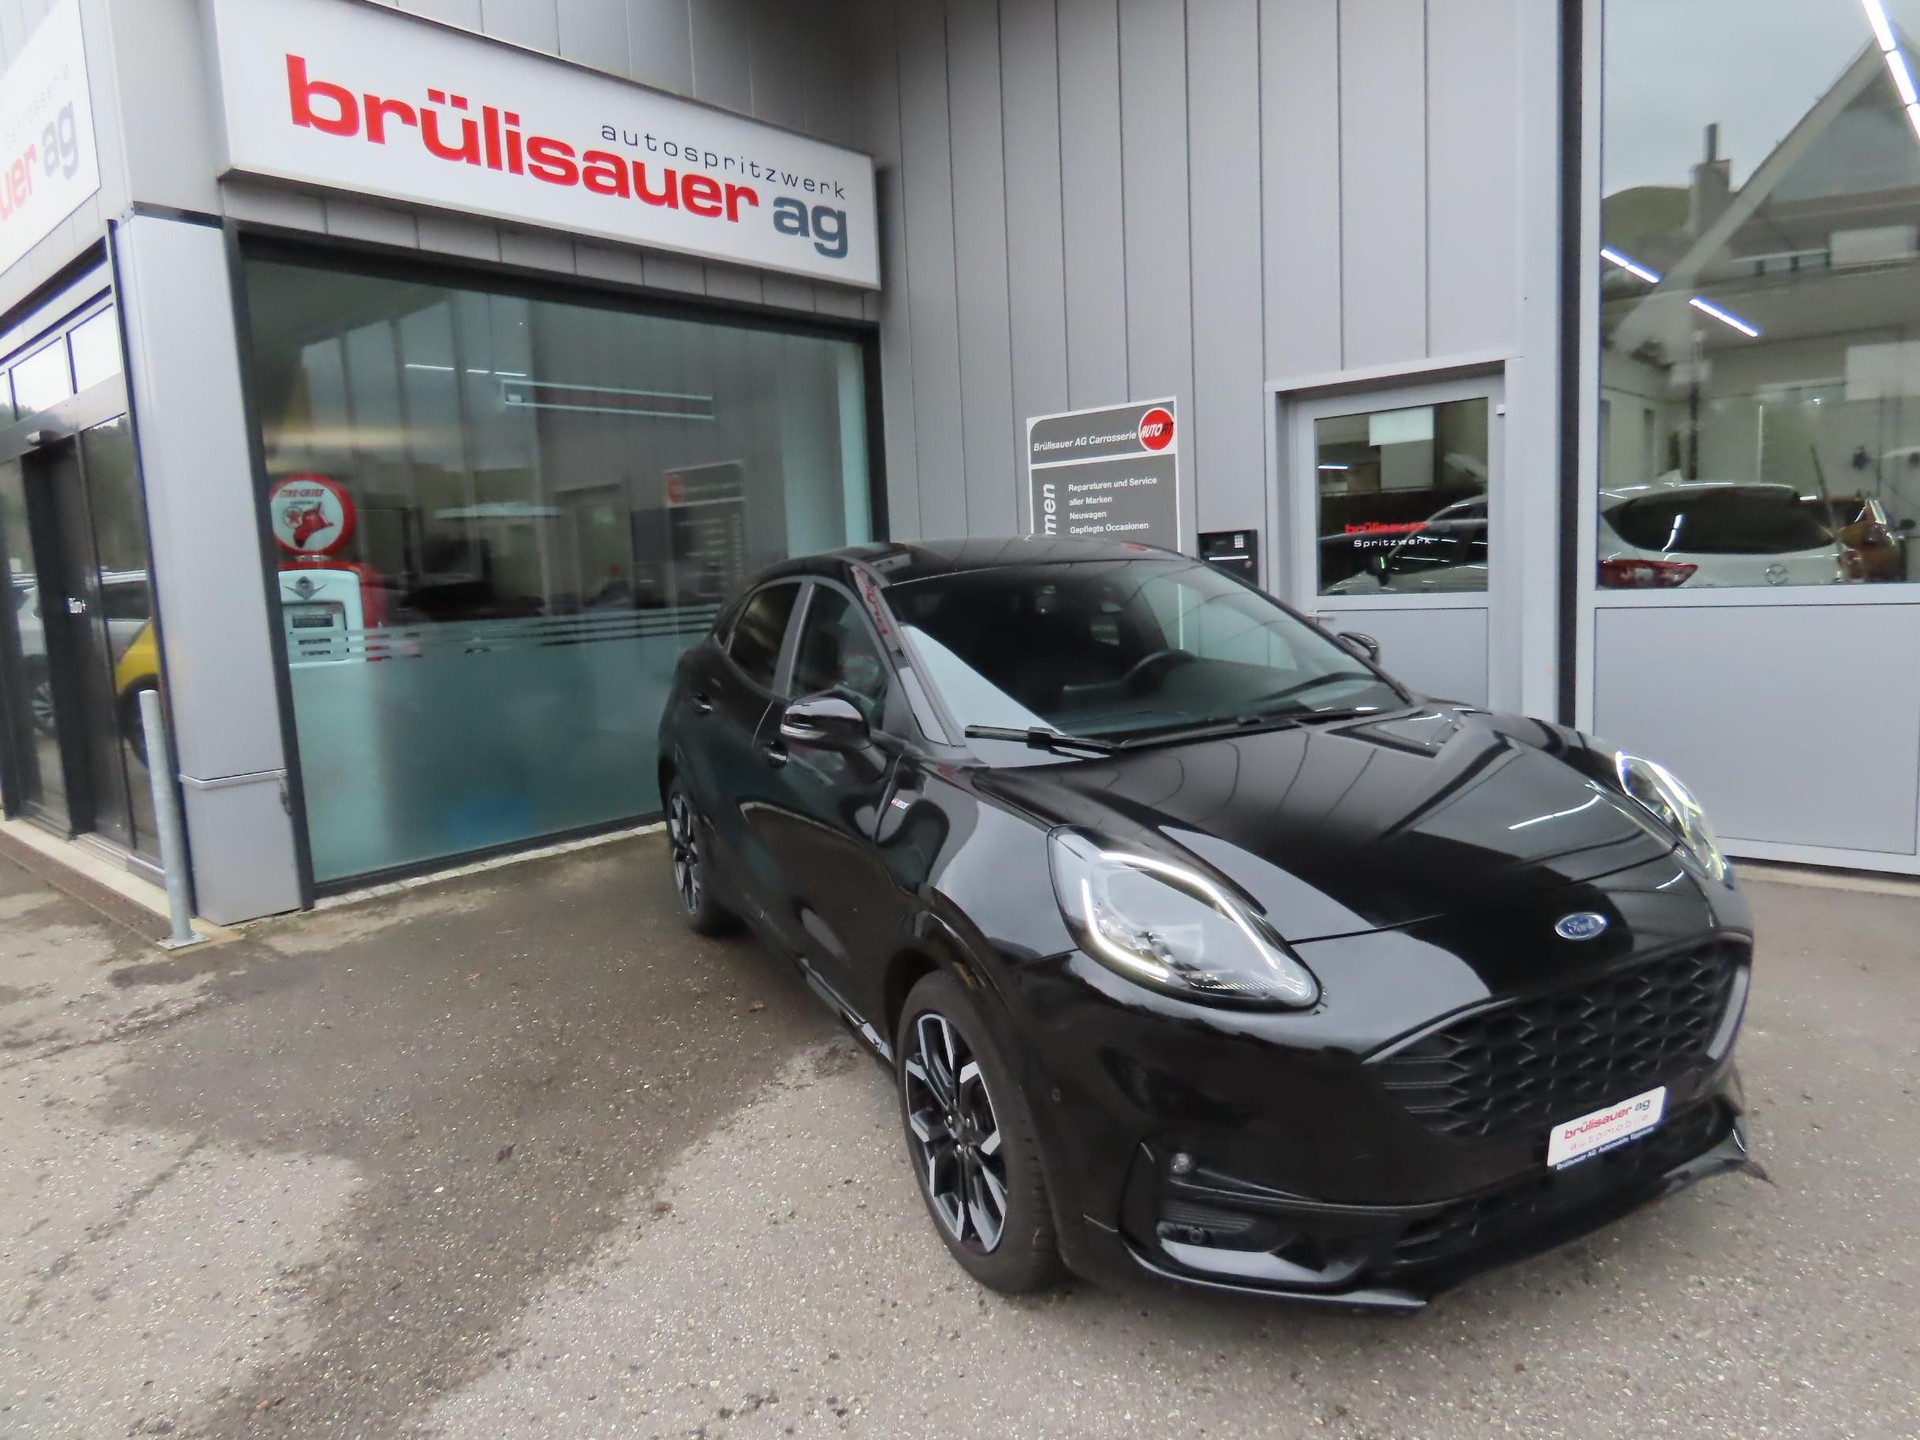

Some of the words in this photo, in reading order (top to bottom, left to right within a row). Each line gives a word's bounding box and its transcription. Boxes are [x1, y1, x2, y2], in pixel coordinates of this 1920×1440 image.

[42, 100, 79, 180] ag
[286, 54, 759, 222] brülisauer
[772, 196, 849, 258] ag
[601, 123, 846, 200] autospritzwerk
[1033, 440, 1073, 452] Brülisauer
[1075, 437, 1087, 447] AG
[1089, 431, 1137, 445] Carrosserie
[1068, 481, 1112, 493] Reparaturen
[1114, 479, 1128, 488] und
[1129, 476, 1158, 487] Service
[1042, 483, 1057, 535] men
[1068, 497, 1084, 506] aller
[1085, 496, 1113, 505] Marken
[1069, 511, 1107, 521] Neuwagen
[1069, 525, 1104, 536] Gepflegte
[1105, 522, 1149, 532] Occasionen
[1353, 538, 1432, 549] Spritzwerk
[1564, 1105, 1633, 1141] brülisauer
[1634, 1099, 1651, 1112] ag
[1569, 1113, 1649, 1152] automobe
